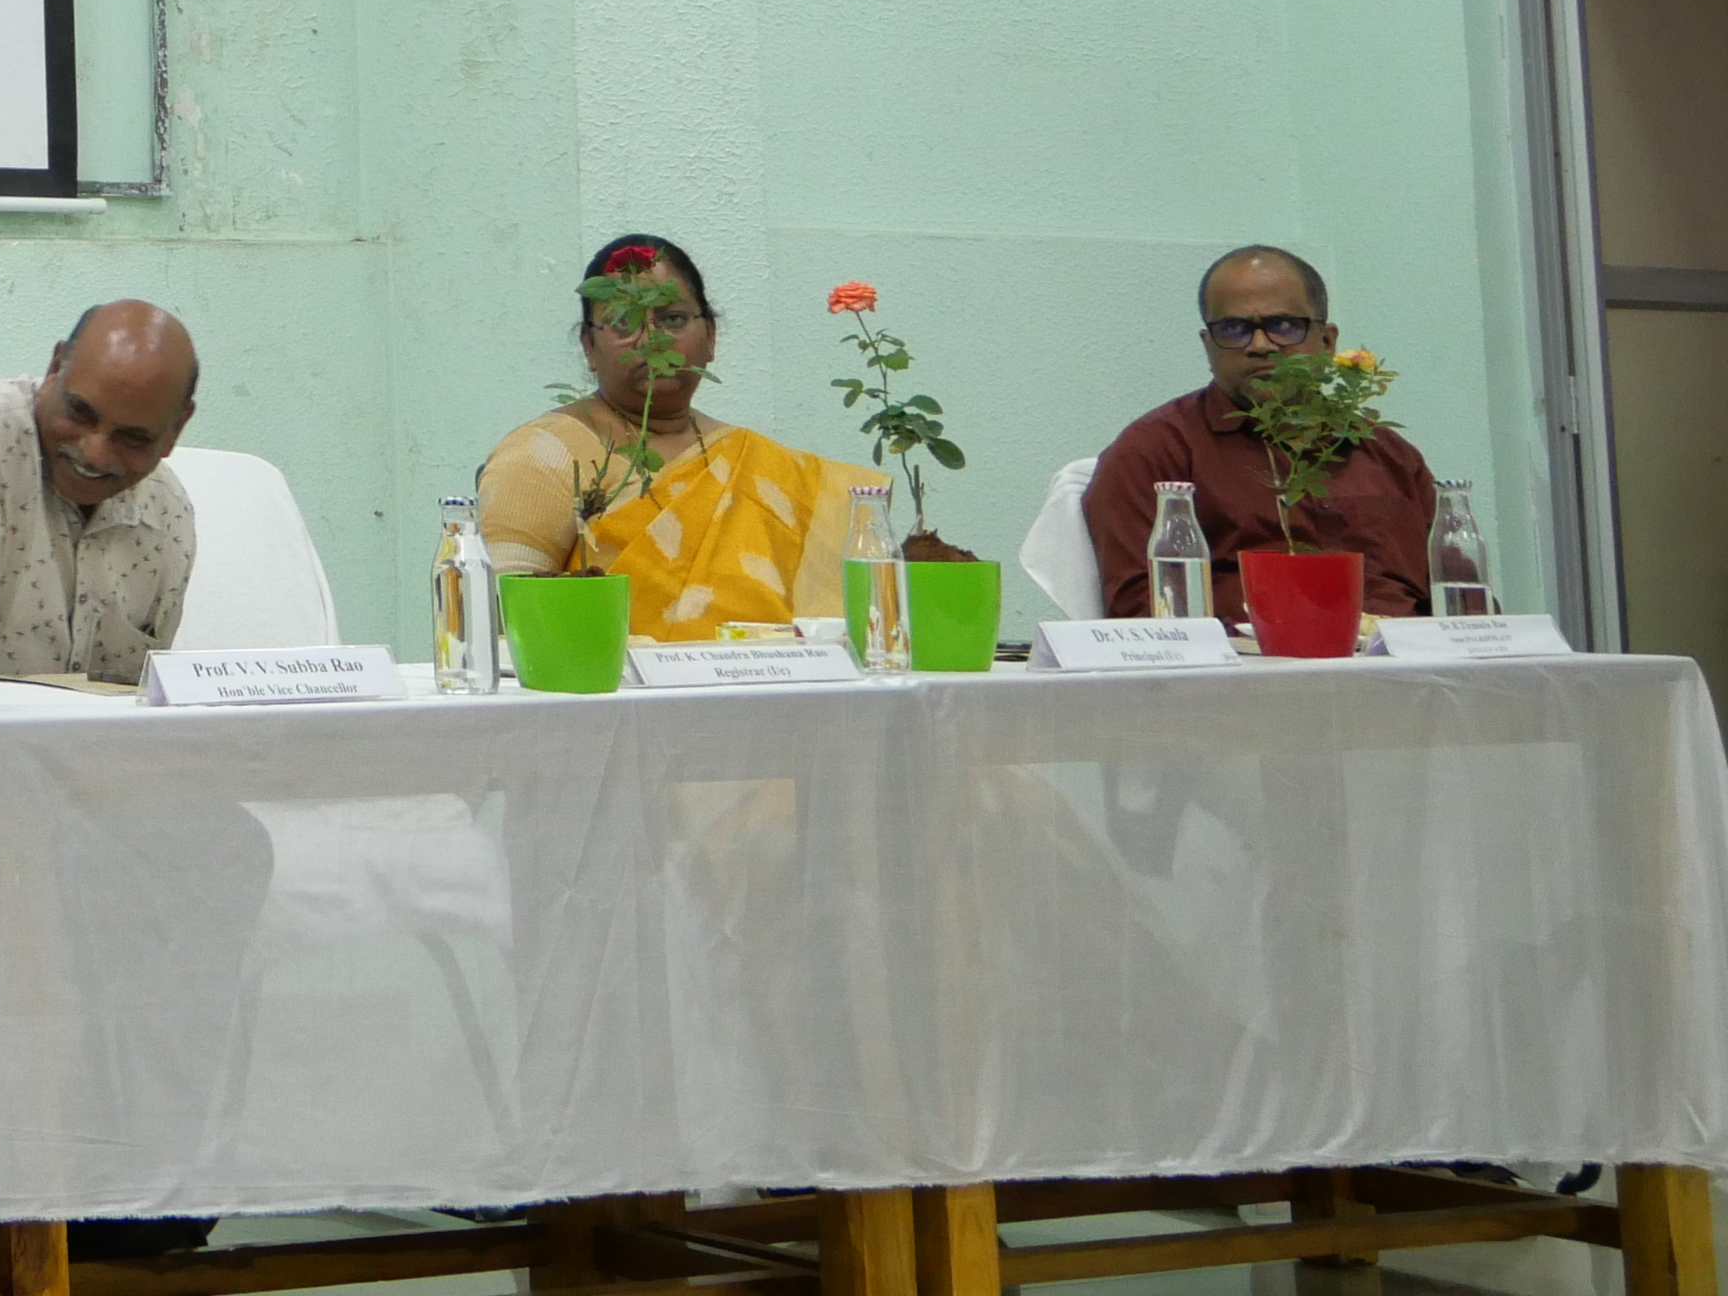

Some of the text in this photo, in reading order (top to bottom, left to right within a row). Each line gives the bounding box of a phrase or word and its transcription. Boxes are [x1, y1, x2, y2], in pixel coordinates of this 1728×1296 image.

[1091, 628, 1189, 642] Dr. V. S. Vakula
[655, 651, 683, 663] Prof.
[701, 651, 750, 661] Chandra
[804, 648, 827, 658] Rao
[192, 658, 364, 678] Prof. V. V. Subba Rao
[714, 666, 765, 679] Registrar
[268, 684, 294, 696] Vice
[296, 682, 359, 695] Chancellor
